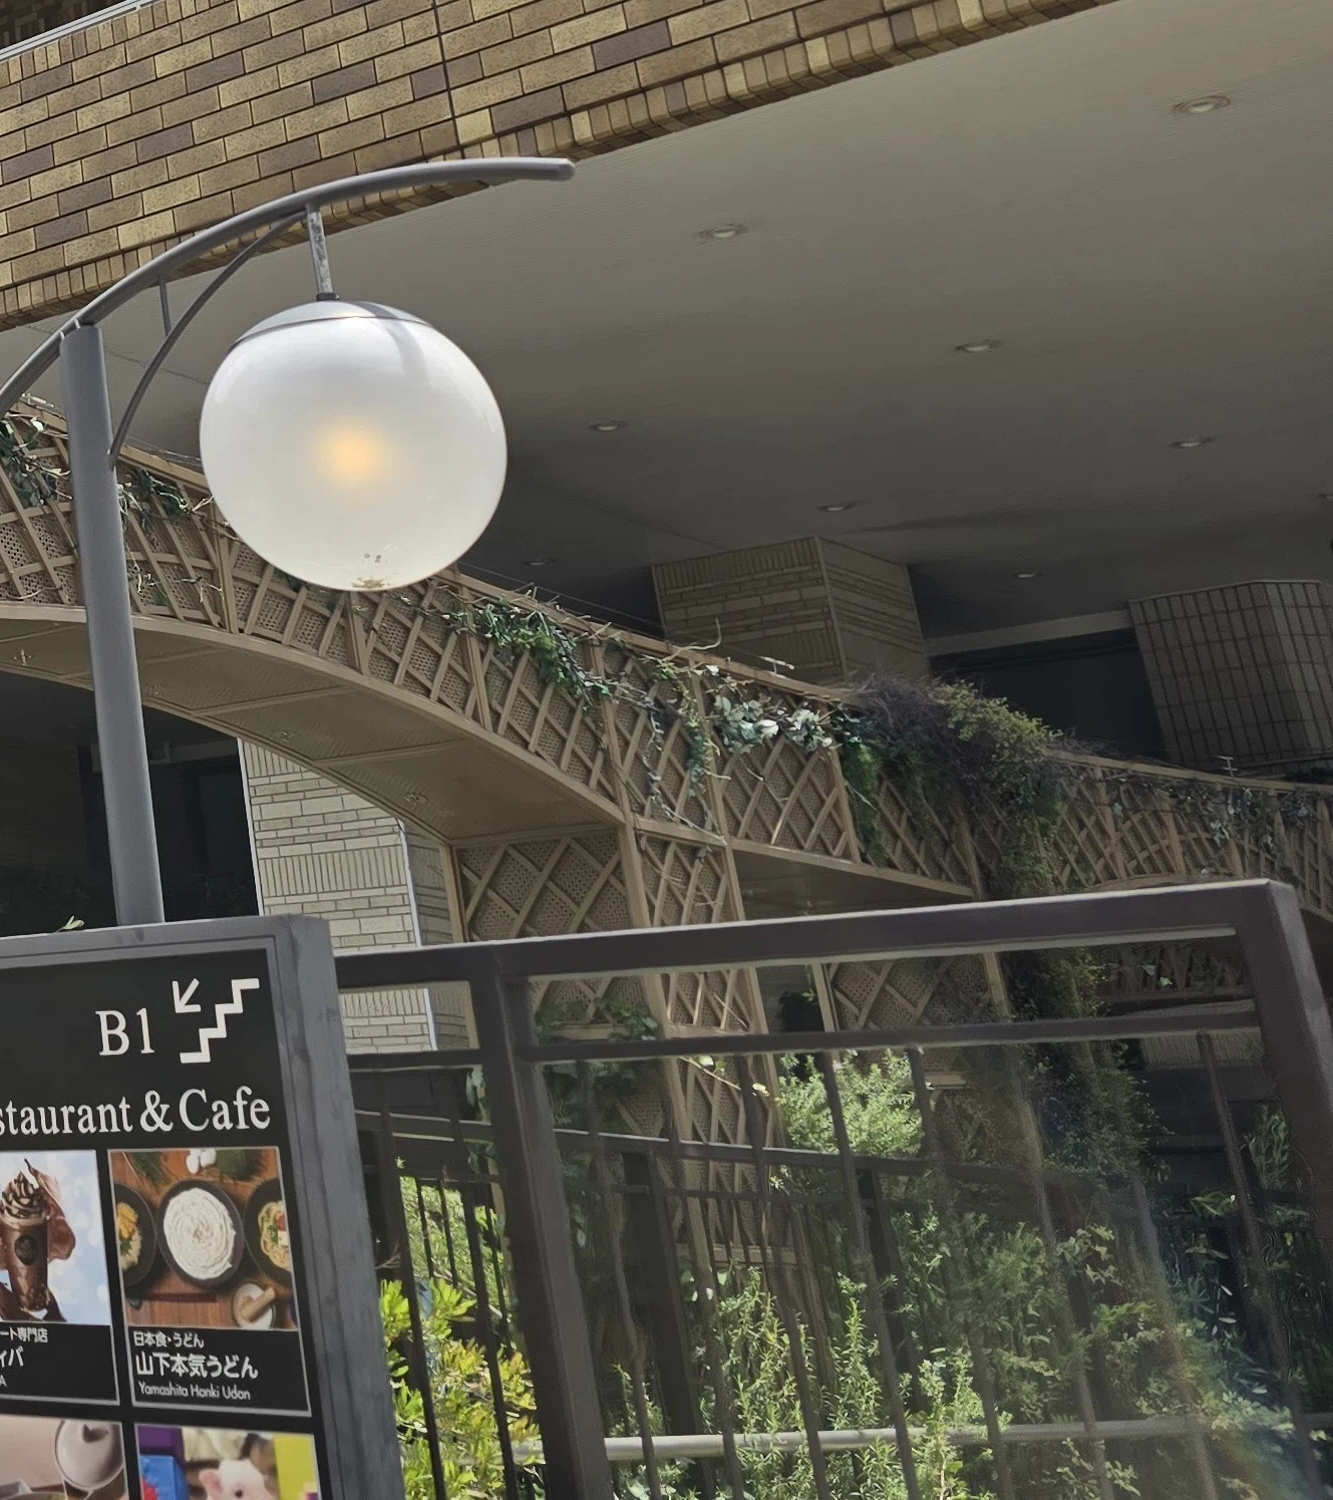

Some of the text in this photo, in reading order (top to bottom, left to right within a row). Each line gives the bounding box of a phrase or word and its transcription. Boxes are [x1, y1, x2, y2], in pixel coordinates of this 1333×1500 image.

[95, 1007, 155, 1057] B1
[132, 1330, 205, 1349] 日本食・うどん
[135, 1351, 259, 1379] 山下本気うどん
[138, 1380, 251, 1401] Yamashita Honki Udon
